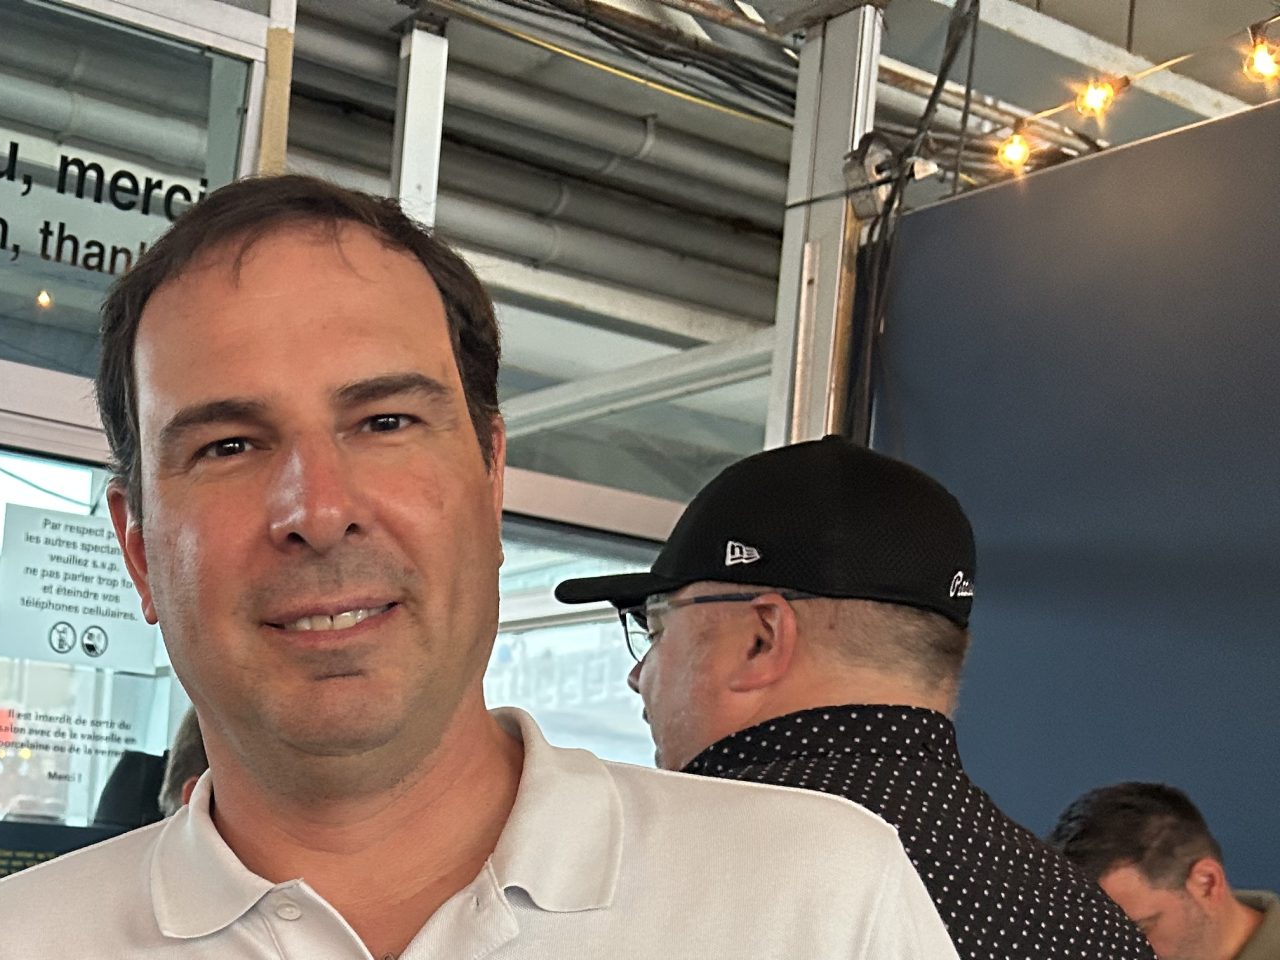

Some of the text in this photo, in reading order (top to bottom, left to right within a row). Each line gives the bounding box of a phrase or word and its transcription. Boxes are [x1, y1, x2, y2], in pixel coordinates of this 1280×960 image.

[42, 518, 62, 530] Par
[64, 523, 105, 538] respect
[23, 532, 41, 544] les
[43, 536, 78, 550] autres
[49, 554, 89, 568] veuillez
[24, 566, 39, 576] ne
[40, 568, 61, 579] pas
[63, 571, 95, 584] parler
[97, 575, 119, 588] trop
[42, 585, 121, 603] et éteindre vos
[19, 596, 80, 614] téléphones
